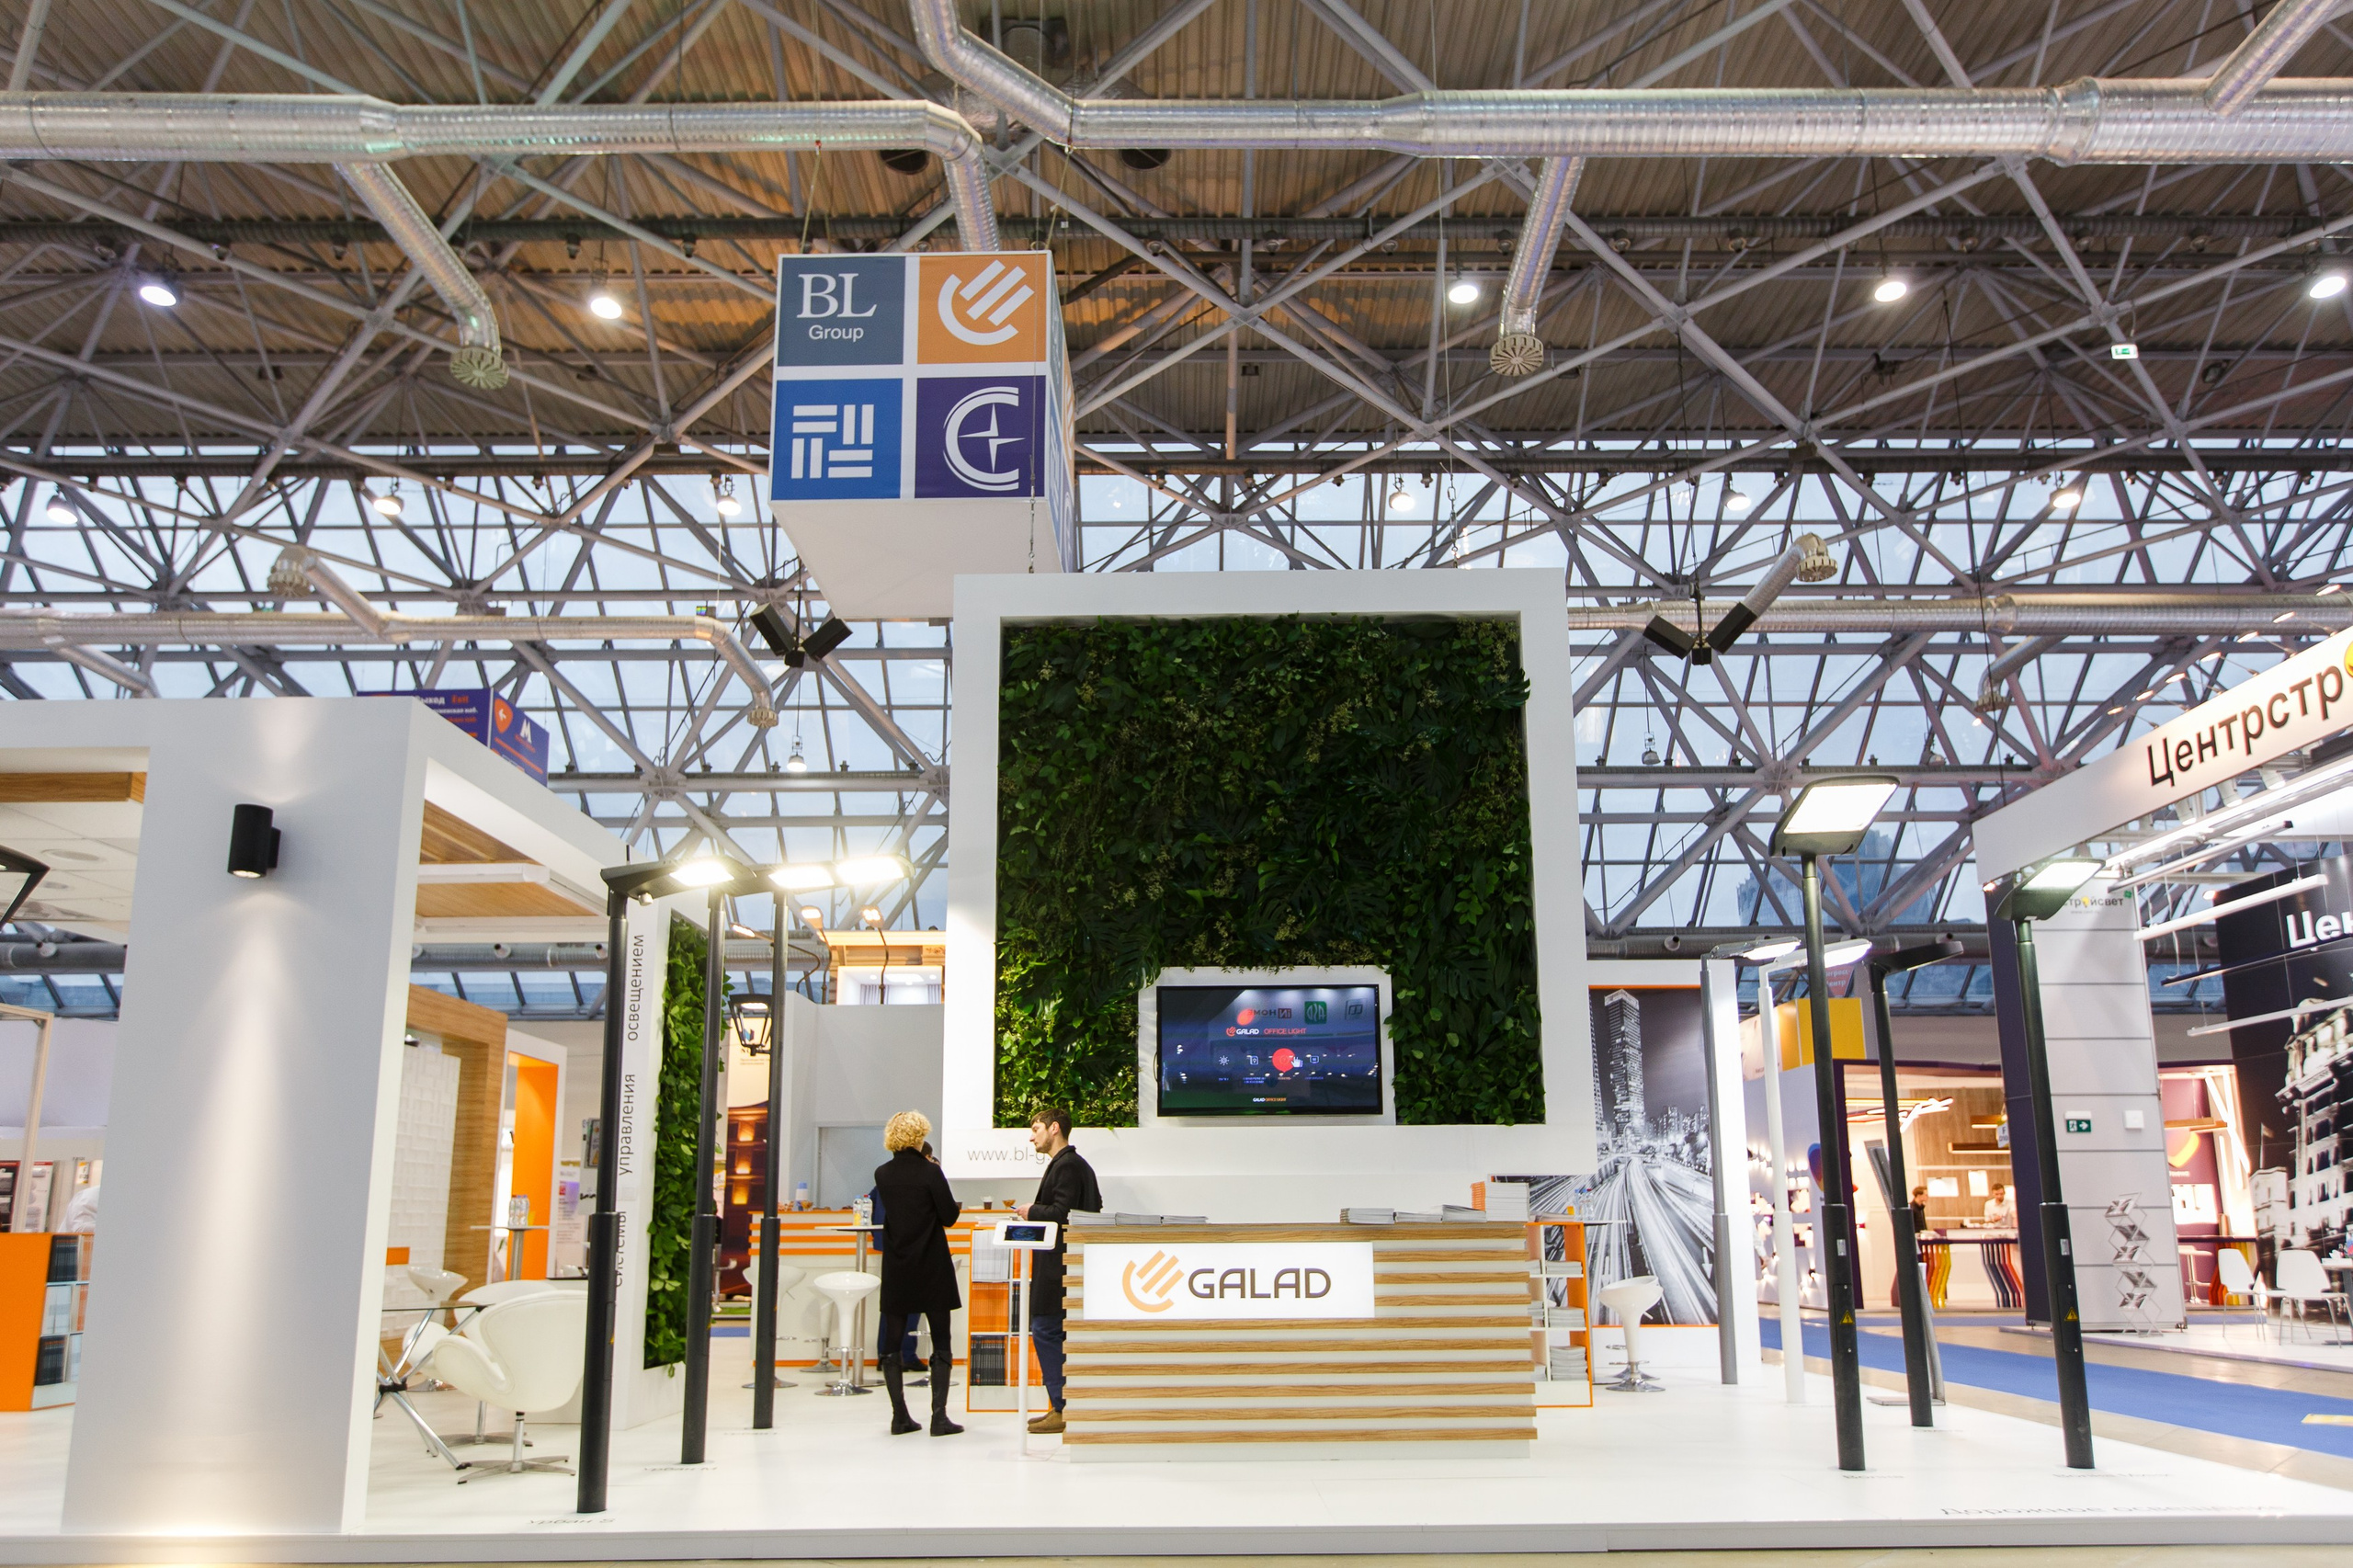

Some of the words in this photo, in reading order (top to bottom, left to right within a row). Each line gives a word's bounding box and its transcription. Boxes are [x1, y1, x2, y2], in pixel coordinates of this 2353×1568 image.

[796, 272, 878, 318] BL
[808, 324, 865, 343] Group
[619, 1074, 635, 1176] управления
[627, 934, 644, 1041] освещением
[1188, 1268, 1331, 1298] GALAD
